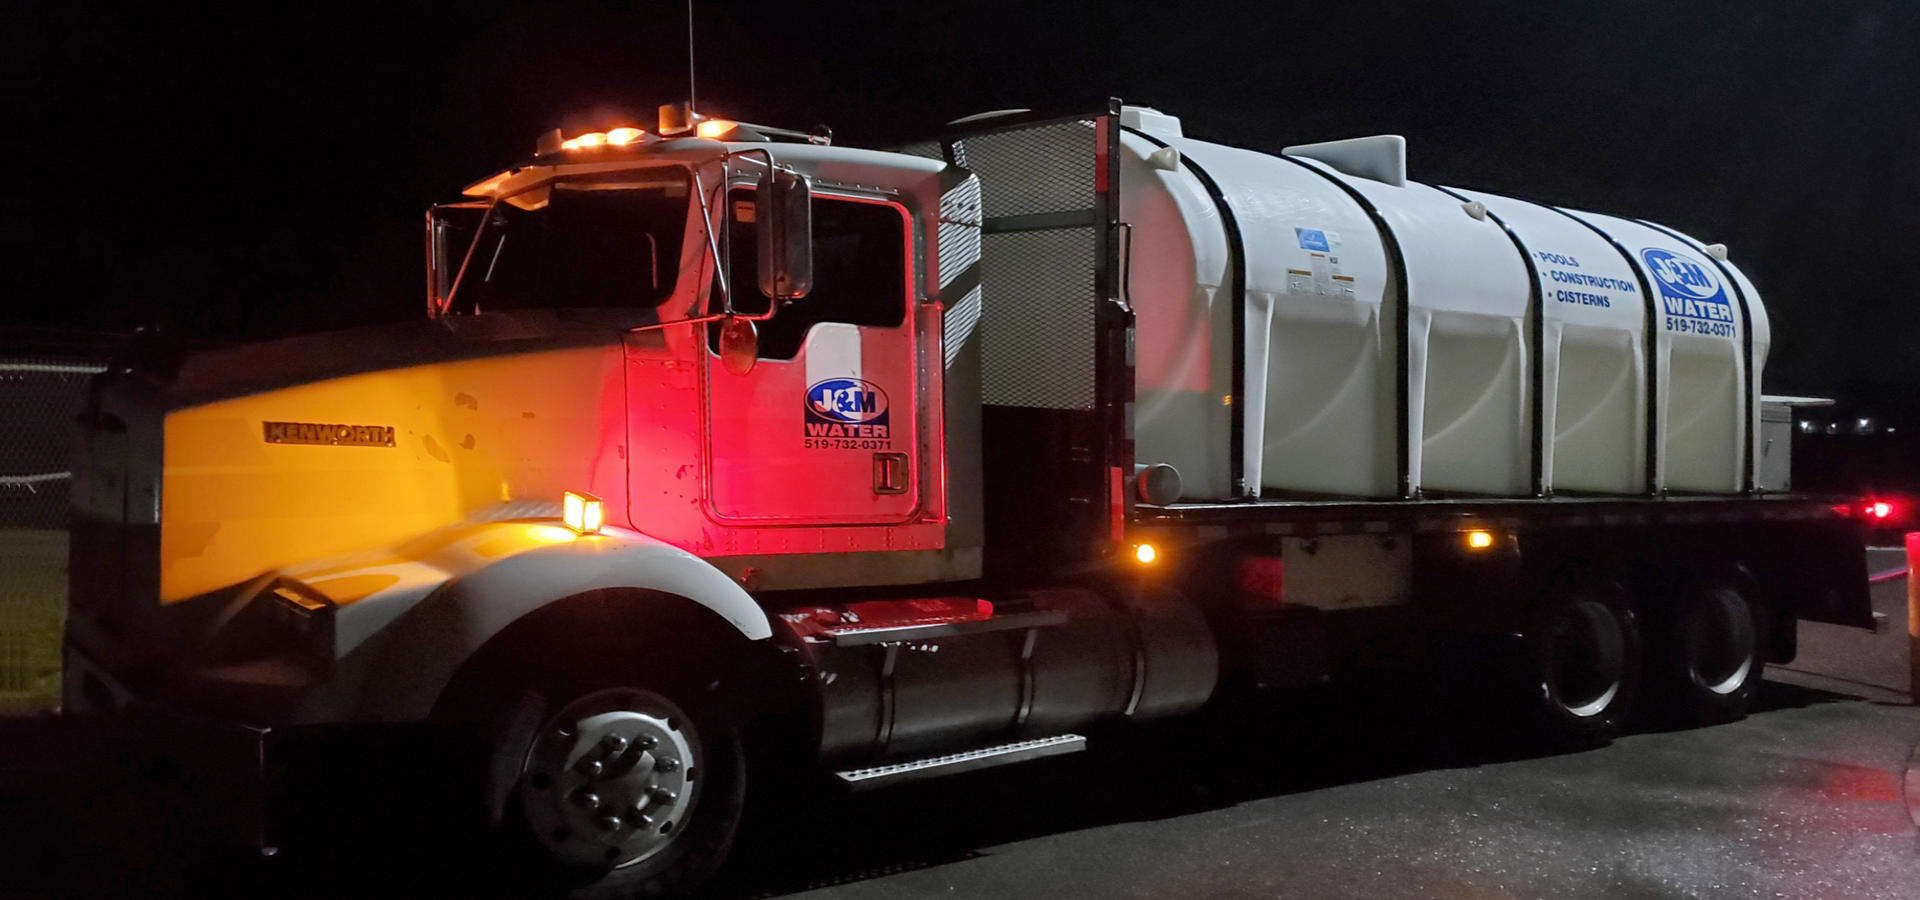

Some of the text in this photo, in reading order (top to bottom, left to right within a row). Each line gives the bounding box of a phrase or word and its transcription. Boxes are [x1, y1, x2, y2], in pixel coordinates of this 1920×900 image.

[1541, 251, 1579, 267] POOLS
[1551, 270, 1635, 293] CONSTRUCTION
[1653, 256, 1712, 289] J&M
[1557, 289, 1610, 308] CISTERNS
[1664, 296, 1733, 322] WATER
[1666, 316, 1736, 338] 519-732-0371
[814, 388, 875, 414] J&M
[264, 421, 396, 446] KENWORTH
[806, 423, 888, 438] WATER
[804, 440, 891, 450] 519-732-0371
